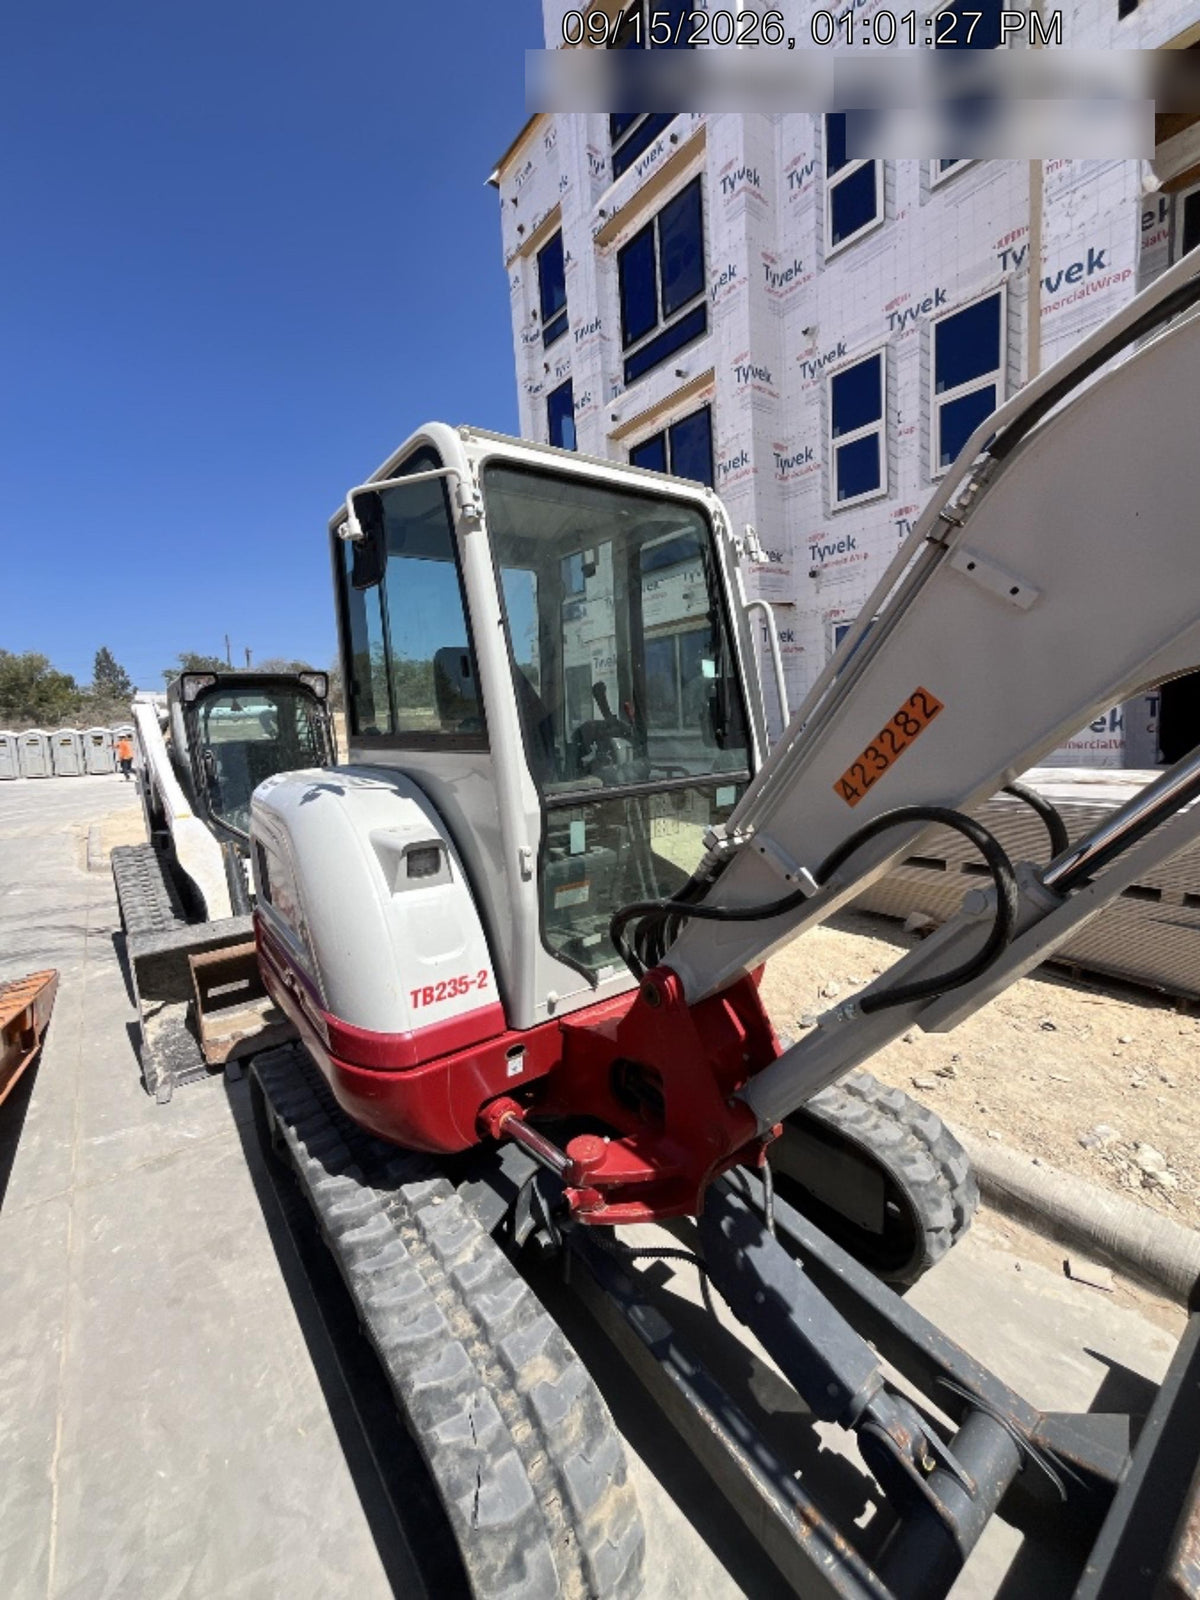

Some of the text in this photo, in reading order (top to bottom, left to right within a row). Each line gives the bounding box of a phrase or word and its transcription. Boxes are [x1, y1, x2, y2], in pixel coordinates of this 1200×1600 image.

[720, 166, 760, 194] Tyvek
[762, 260, 803, 288] Tyvek
[885, 287, 947, 331] Tyvek
[800, 342, 848, 380] Tyvek
[773, 446, 813, 475] Tyvek
[809, 535, 856, 562] Tyvek
[841, 692, 939, 801] 423282
[410, 970, 488, 1009] TB235-2
